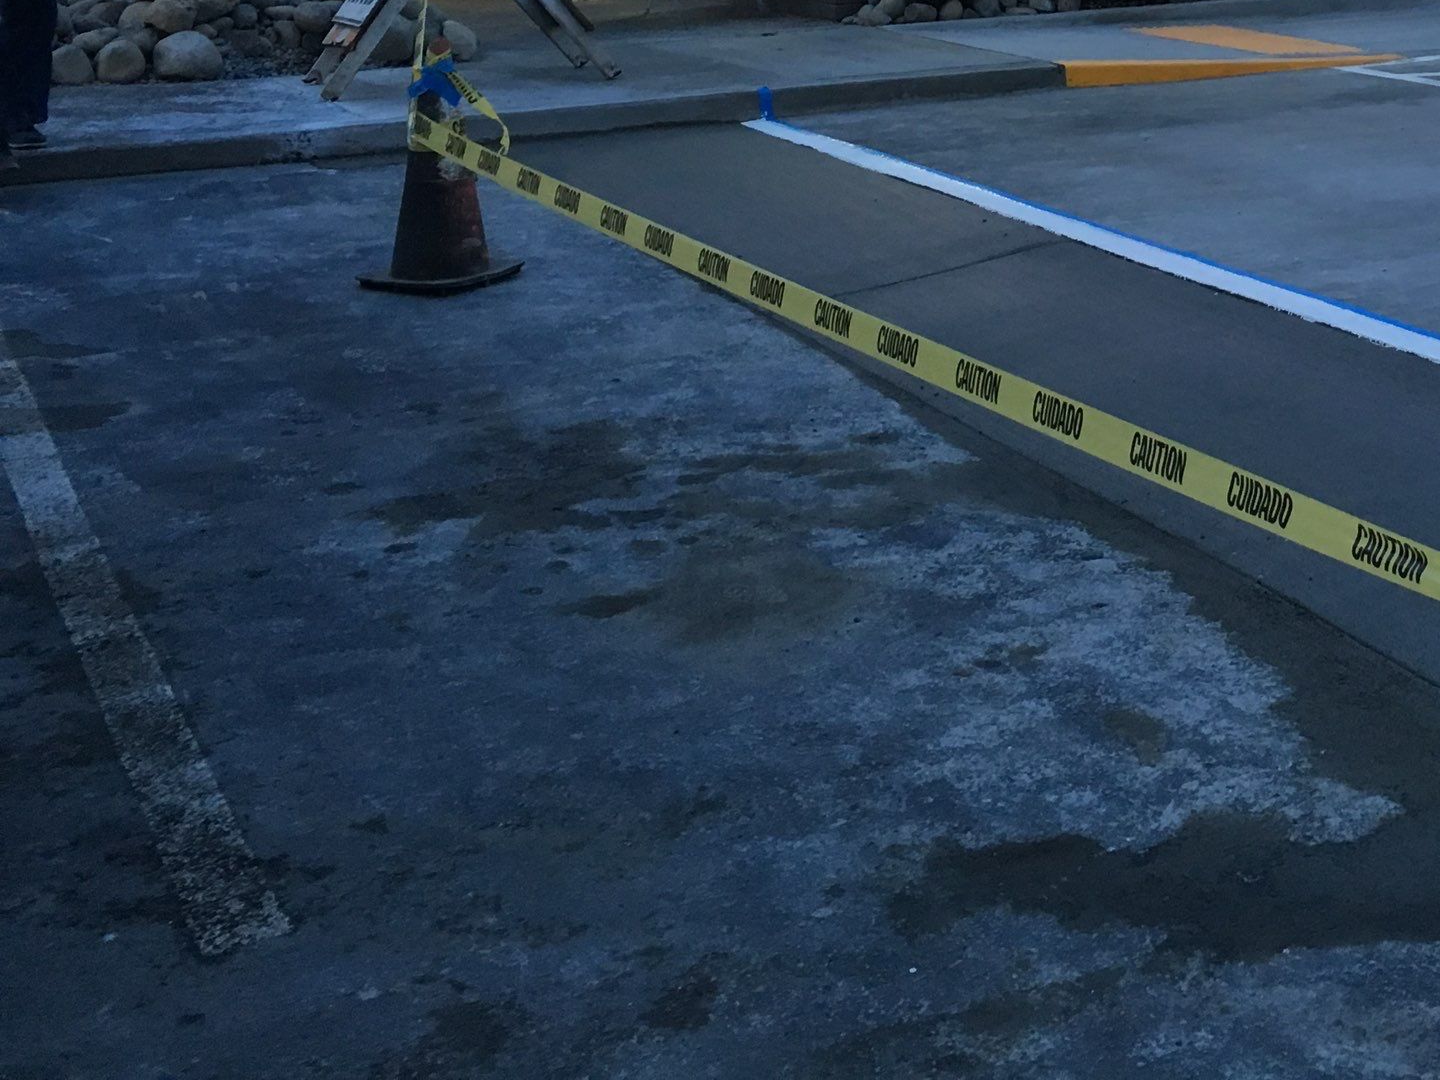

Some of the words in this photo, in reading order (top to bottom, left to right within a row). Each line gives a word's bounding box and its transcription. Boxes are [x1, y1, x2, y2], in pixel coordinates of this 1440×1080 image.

[698, 247, 731, 283] CAUTION
[749, 270, 786, 309] CUIDADO
[814, 297, 853, 339] CAUTION
[876, 324, 919, 368] CUIDADO
[955, 358, 1002, 405] CAUTION
[1032, 390, 1085, 441] CUIDADO
[1129, 431, 1188, 486] CAUTION
[1226, 471, 1294, 530] CUIDADO
[1351, 523, 1429, 585] CAUTION
